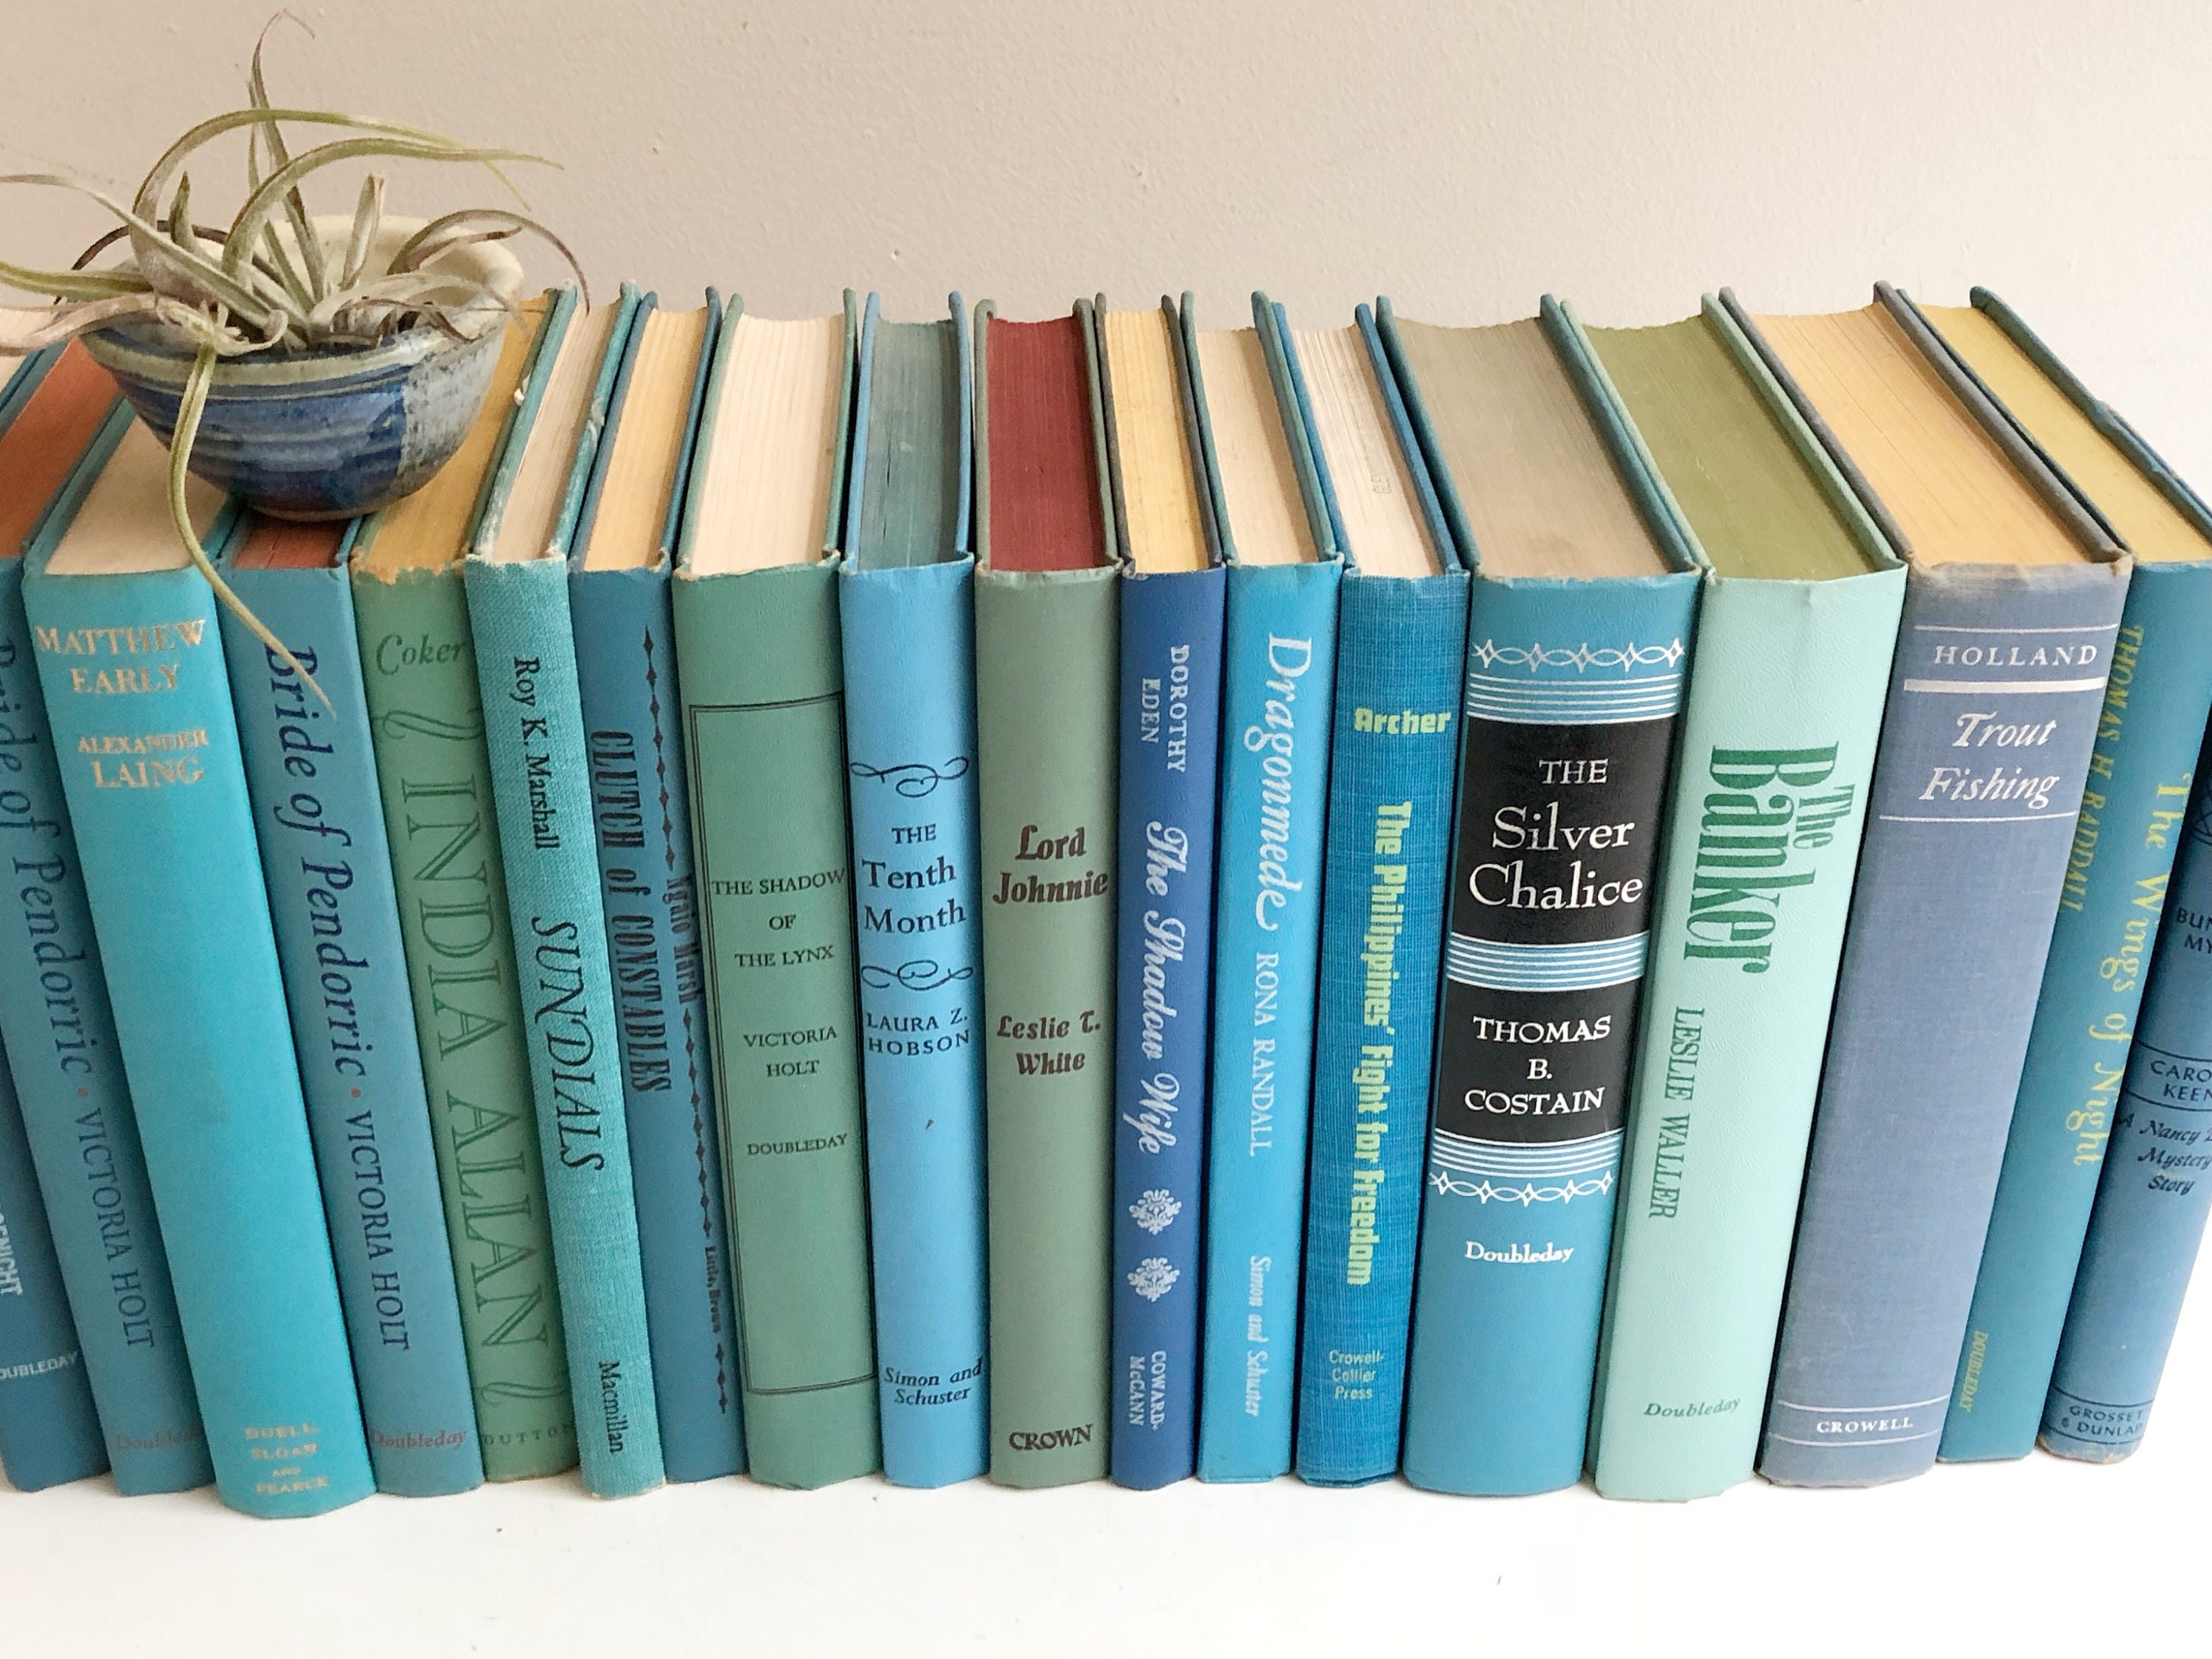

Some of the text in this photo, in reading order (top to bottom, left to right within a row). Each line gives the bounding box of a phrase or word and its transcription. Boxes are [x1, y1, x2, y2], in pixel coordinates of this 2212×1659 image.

[35, 619, 206, 655] MATTHEW
[375, 633, 467, 675] Coker
[1934, 644, 2098, 667] HOLLAND
[70, 663, 180, 695] EARLY
[2097, 625, 2144, 742] THOMAS
[1141, 678, 1161, 744] EDEN
[1167, 644, 1190, 773] DOROTHY
[1354, 707, 1452, 735] Archer
[78, 728, 209, 754] ALEXANDER
[1952, 711, 2056, 747] Trout
[509, 656, 560, 849] Roy K. Marshall
[91, 755, 205, 788] LAING
[1243, 632, 1312, 932] Dragonmede
[1539, 758, 1609, 784] THE
[1918, 767, 2060, 810] Fishing
[0, 790, 61, 838] of
[1374, 801, 1412, 855] The
[1492, 801, 1635, 850] Silver
[1793, 784, 1855, 849] The
[891, 824, 936, 844] THE
[1015, 824, 1086, 860] Lord
[265, 644, 373, 1078] Bride of Pendorric
[861, 856, 957, 889] Tenth
[1683, 740, 1840, 973] Banker
[712, 868, 846, 895] THE SHADOW
[992, 870, 1108, 904] Johnnie
[1469, 859, 1644, 909] Chalice
[591, 731, 672, 1091] CLUTCH of CONSTABLES
[769, 914, 796, 931] OF
[863, 898, 967, 934] Month
[662, 874, 703, 1004] Ngaio Marsh
[734, 945, 835, 967] THE LYNX
[12, 853, 98, 1074] Pendorric
[2066, 773, 2192, 1166] The Wings of Night
[1122, 821, 1188, 1155] The Shadow Wife
[743, 1026, 837, 1047] VICTORIA
[866, 1008, 968, 1032] LAURA Z.
[997, 1010, 1101, 1040] Leslie T.
[1473, 1015, 1612, 1044] THOMAS
[401, 773, 549, 1347] INDIA ALLAN
[531, 917, 605, 1170] SUNDIALS
[867, 1029, 970, 1057] HOBSON
[1249, 952, 1279, 1158] RONA RANDALL
[766, 1060, 819, 1077] HOLT
[1016, 1052, 1086, 1076] White
[1353, 1045, 1394, 1114] Fight
[1527, 1058, 1553, 1080] B.
[1464, 1087, 1605, 1115] COSTAIN
[1649, 1006, 1705, 1219] LESLIE WALLER
[747, 1133, 847, 1155] DOUBLEDAY
[1354, 1122, 1389, 1164] for
[2139, 1119, 2200, 1146] Nancy
[2138, 1147, 2212, 1170] Mystery
[2148, 1175, 2195, 1196] Story
[74, 1107, 154, 1348] VICTORIA HOLT
[345, 1109, 410, 1351] VICTORIA HOLT
[1346, 1169, 1385, 1286] Freedom
[1464, 1240, 1574, 1264] Doubleday
[1245, 1256, 1272, 1417] Simon and Schuster
[885, 1355, 983, 1386] Simon and
[1332, 1368, 1376, 1382] Collier
[599, 1362, 628, 1454] Macmillan
[894, 1387, 971, 1405] Schuster
[1129, 1355, 1145, 1427] McCANN
[1335, 1385, 1373, 1399] Press
[1644, 1398, 1740, 1417] Doubleday
[1816, 1416, 1913, 1433] CROWELL
[2070, 1405, 2143, 1422] GROSSET
[2077, 1422, 2143, 1436] DUNLAP
[369, 1429, 468, 1450] Doubleday
[1009, 1424, 1093, 1450] CROWN
